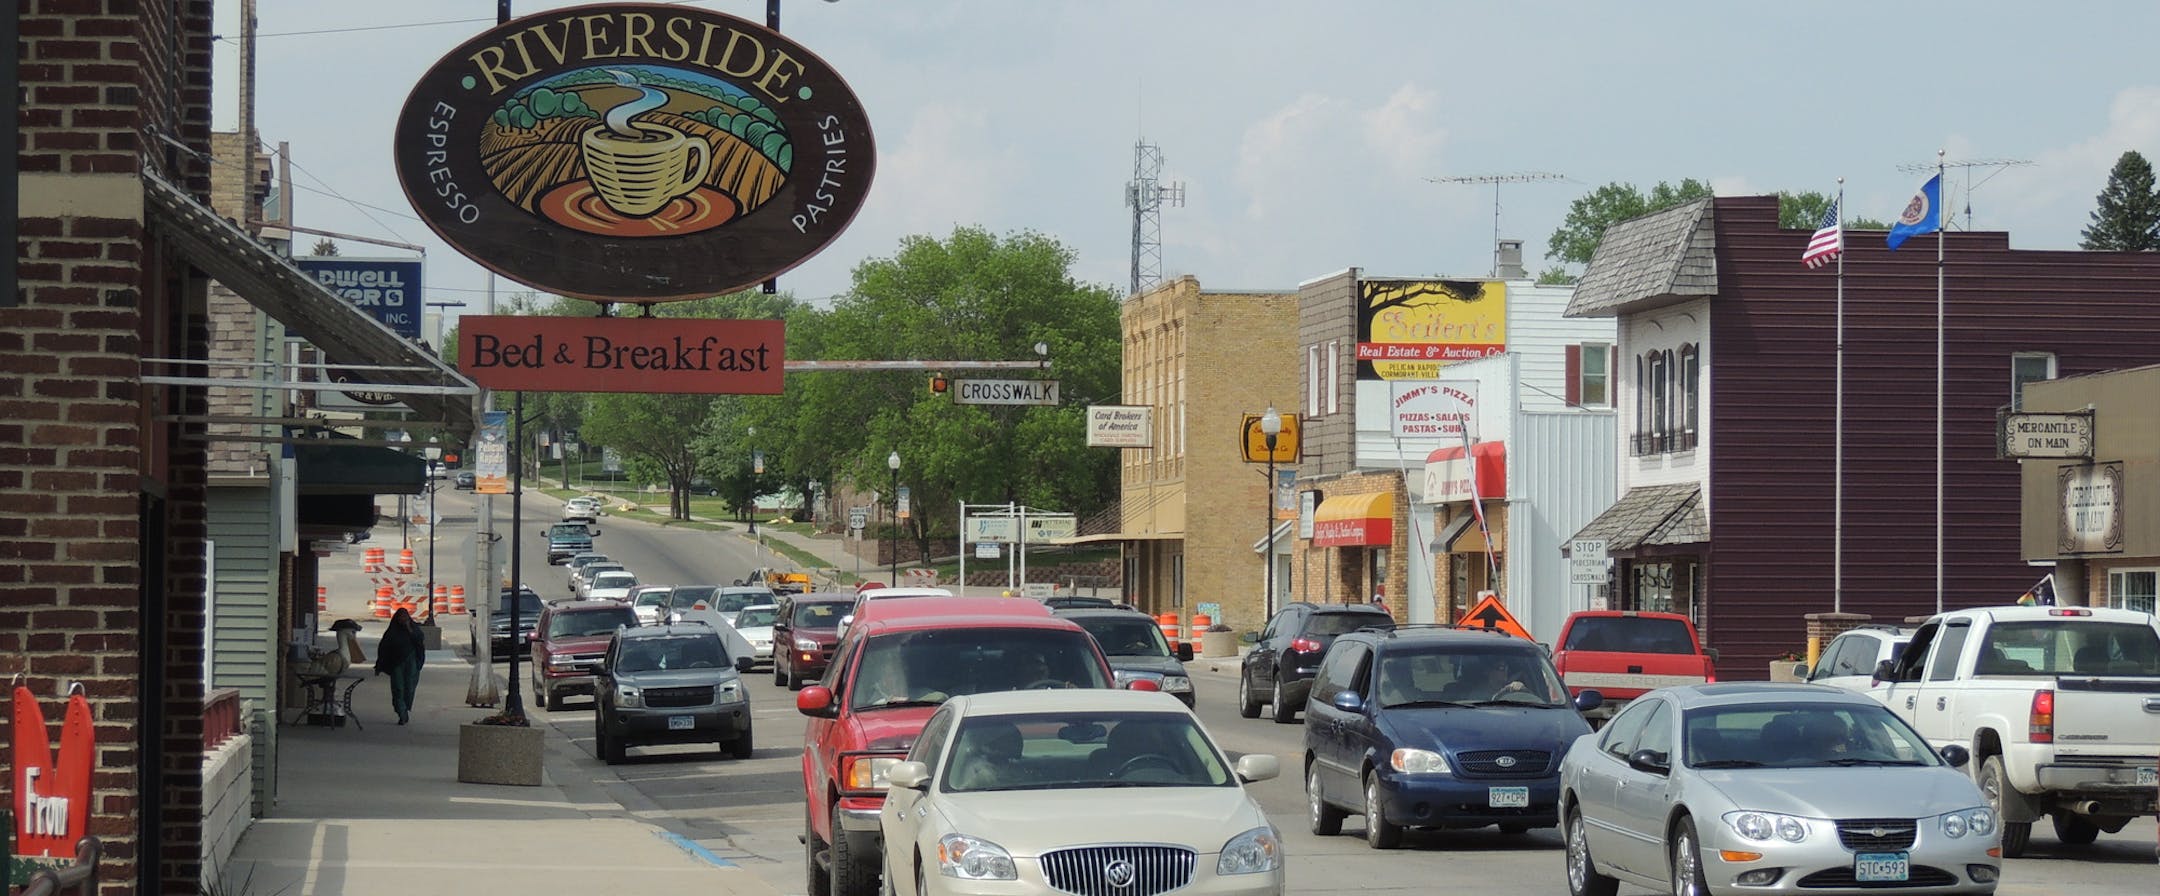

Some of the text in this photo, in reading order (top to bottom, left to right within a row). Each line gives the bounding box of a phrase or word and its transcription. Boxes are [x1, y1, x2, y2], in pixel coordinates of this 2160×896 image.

[468, 13, 805, 103] RIVERSIDE
[426, 101, 480, 225] ESPRESSO
[791, 114, 846, 234] PASTRIES
[385, 313, 412, 324] INC.
[470, 334, 770, 373] Bed & Breakfast
[1359, 345, 1382, 358] Real
[1386, 345, 1421, 358] Estate
[1425, 346, 1440, 358] &
[1442, 346, 1481, 359] Auction
[1389, 363, 1415, 371] PELICAN
[961, 383, 1053, 400] CROSSWALK
[1394, 386, 1475, 408] JIMMY'S PIZZA
[1095, 411, 1142, 420] Card Brokers
[1400, 413, 1430, 422] PIZZAS
[1098, 422, 1138, 431] of America
[1402, 425, 1462, 433] PASTAS SUB
[2017, 422, 2078, 434] MERCANTILE
[2028, 438, 2069, 448] ON MAIN
[852, 518, 864, 527] 59
[1575, 542, 1602, 552] STOP
[2139, 773, 2153, 783] 369
